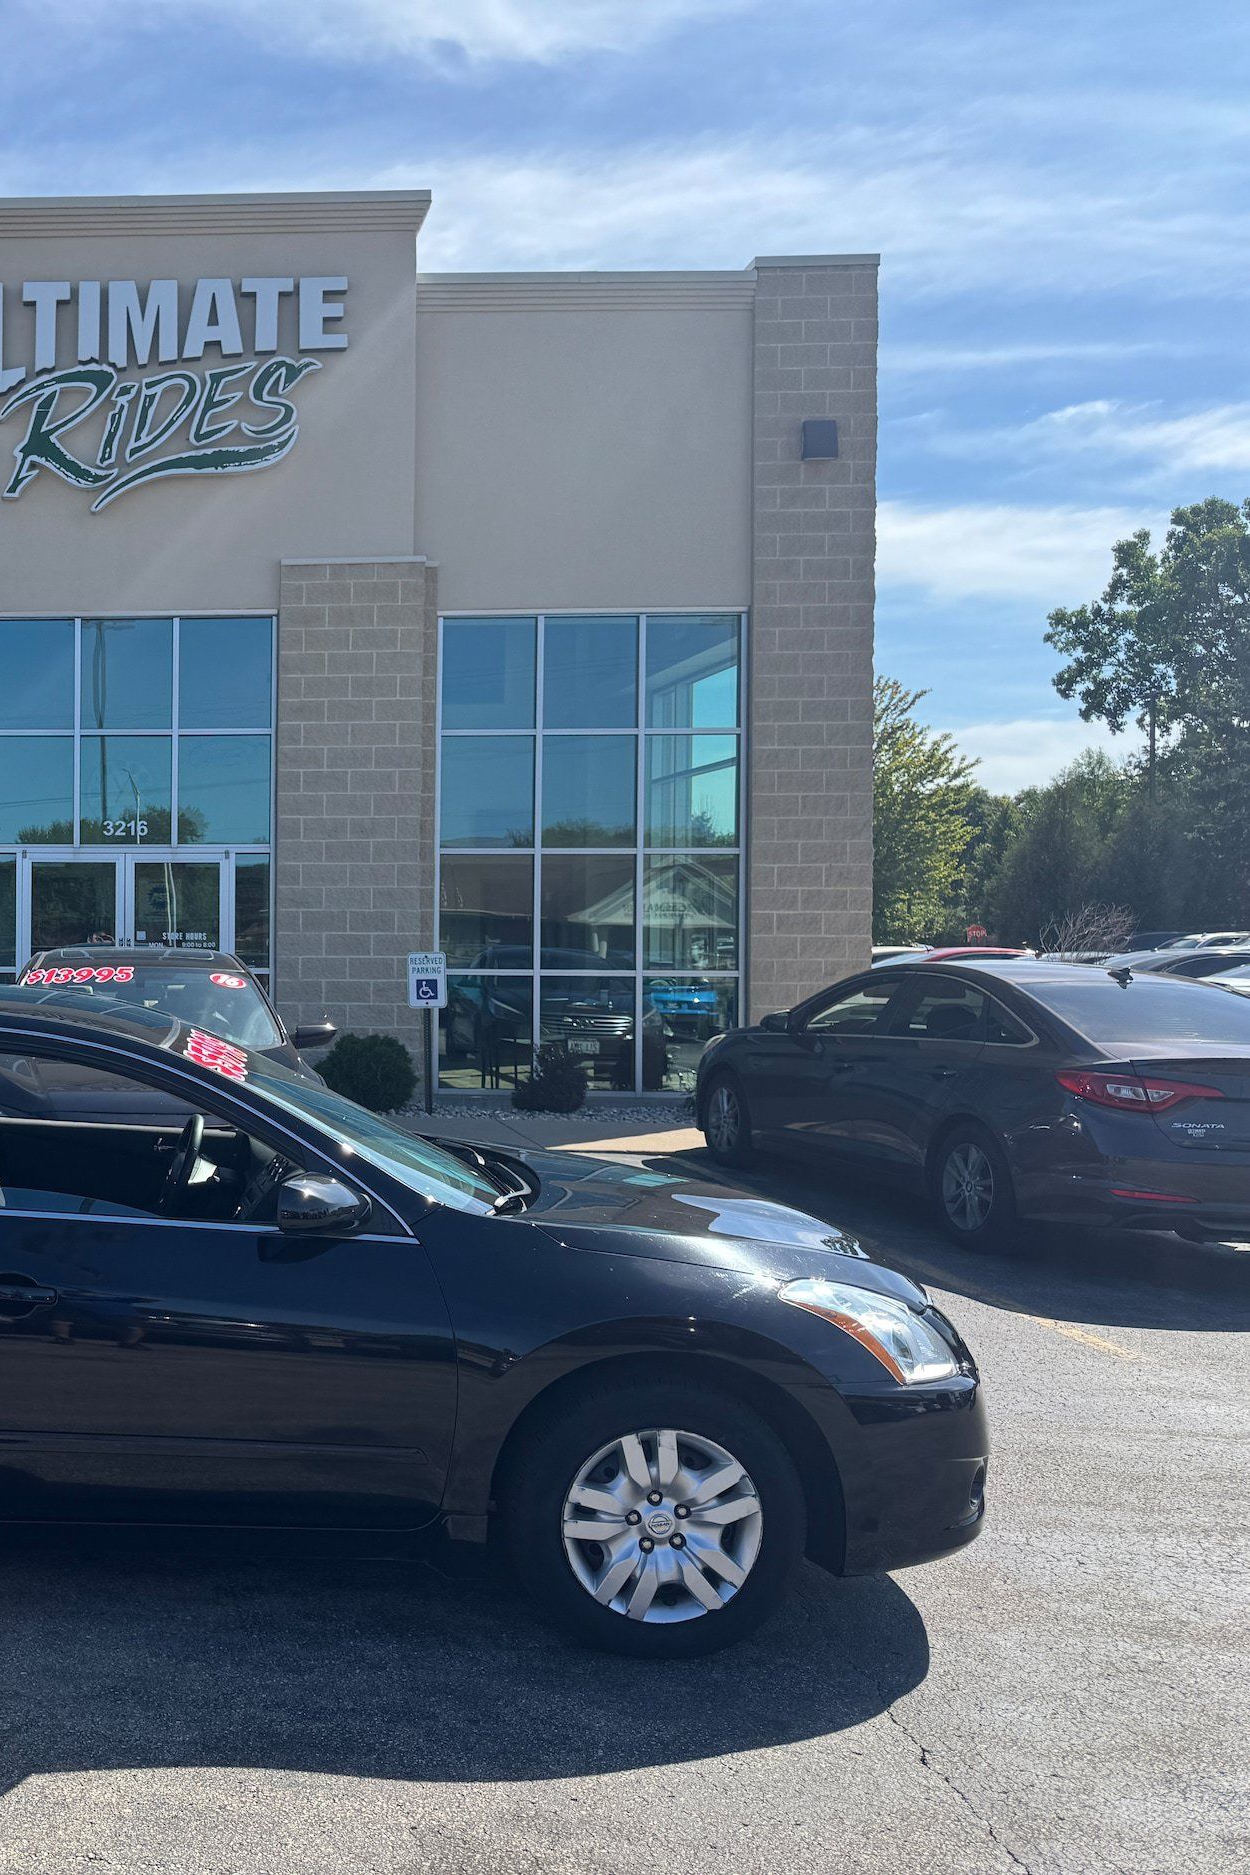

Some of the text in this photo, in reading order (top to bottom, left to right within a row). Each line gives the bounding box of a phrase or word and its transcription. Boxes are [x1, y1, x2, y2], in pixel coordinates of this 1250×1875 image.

[102, 820, 148, 836] 3216
[162, 932, 207, 940] STORE HOURS
[968, 929, 986, 938] STOP
[410, 957, 443, 965] RESERVED
[27, 967, 135, 985] $13995
